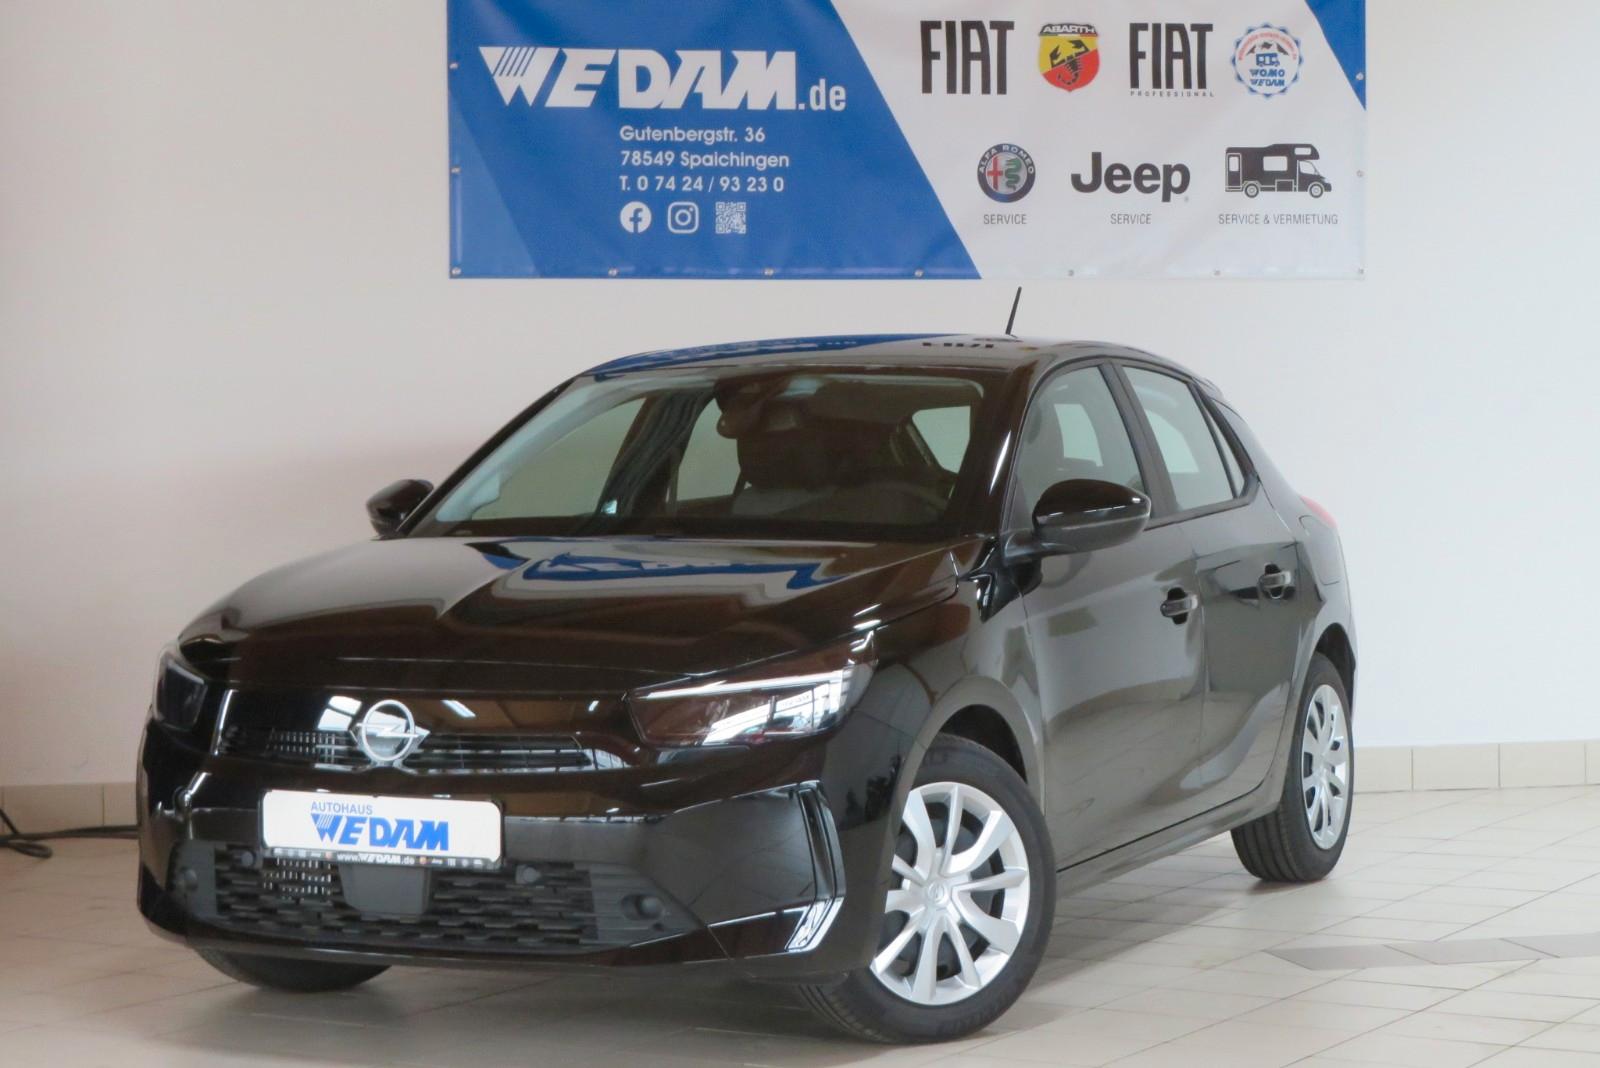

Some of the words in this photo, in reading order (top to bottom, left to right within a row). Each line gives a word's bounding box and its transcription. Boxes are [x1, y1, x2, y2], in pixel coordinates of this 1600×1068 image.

[1043, 24, 1096, 33] ABARTH
[920, 20, 1015, 95] FIAT
[1129, 22, 1213, 90] FIAT
[619, 125, 738, 146] Gutenbergstr.
[744, 127, 766, 142] 36
[620, 150, 675, 167] 78549
[680, 151, 790, 171] Spaichingen
[979, 148, 998, 174] ALFA
[1002, 144, 1034, 174] ROMEO
[619, 175, 631, 191] T.
[636, 175, 649, 191] 0
[655, 176, 676, 191] 74
[682, 176, 704, 192] 24
[719, 176, 741, 192] 93
[746, 177, 768, 192] 23
[773, 177, 785, 192] 0
[1071, 151, 1191, 203] Jeep
[983, 213, 1027, 225] SERVICE
[1110, 213, 1152, 225] SERVICE
[1218, 213, 1260, 225] SERVICE
[1263, 213, 1270, 225] &
[1272, 213, 1339, 225] VERMIETUNG
[311, 801, 373, 815] AUTOHAUS
[310, 813, 449, 851] WEDAM
